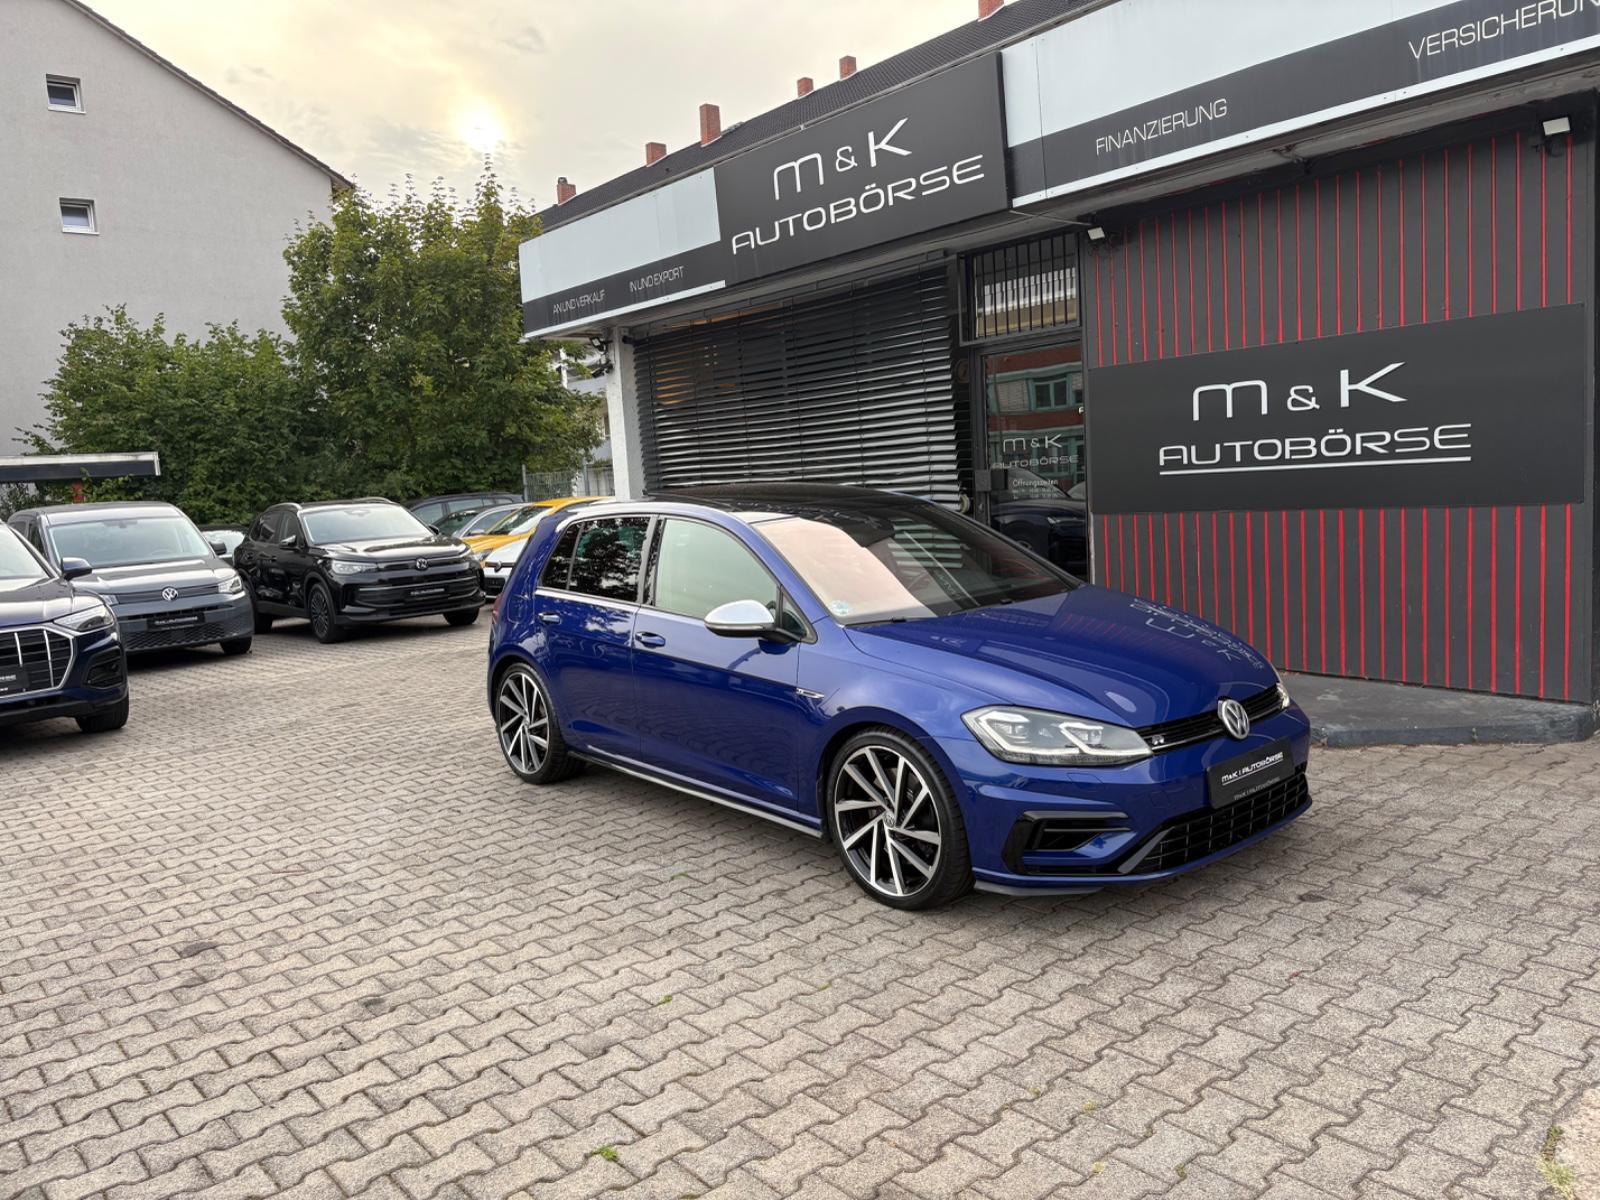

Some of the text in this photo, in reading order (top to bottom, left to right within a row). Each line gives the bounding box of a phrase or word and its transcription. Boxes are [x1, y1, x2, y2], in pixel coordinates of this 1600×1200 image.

[835, 146, 858, 172] &
[867, 117, 912, 168] K
[1095, 98, 1228, 156] FINANZIERUNG
[731, 154, 985, 255] AUTOBÖRSE
[1192, 361, 1408, 422] M & K
[991, 455, 1079, 469] AUTOBÖRSE
[1044, 433, 1062, 449] K
[1159, 423, 1472, 467] AUTOBÖRSE
